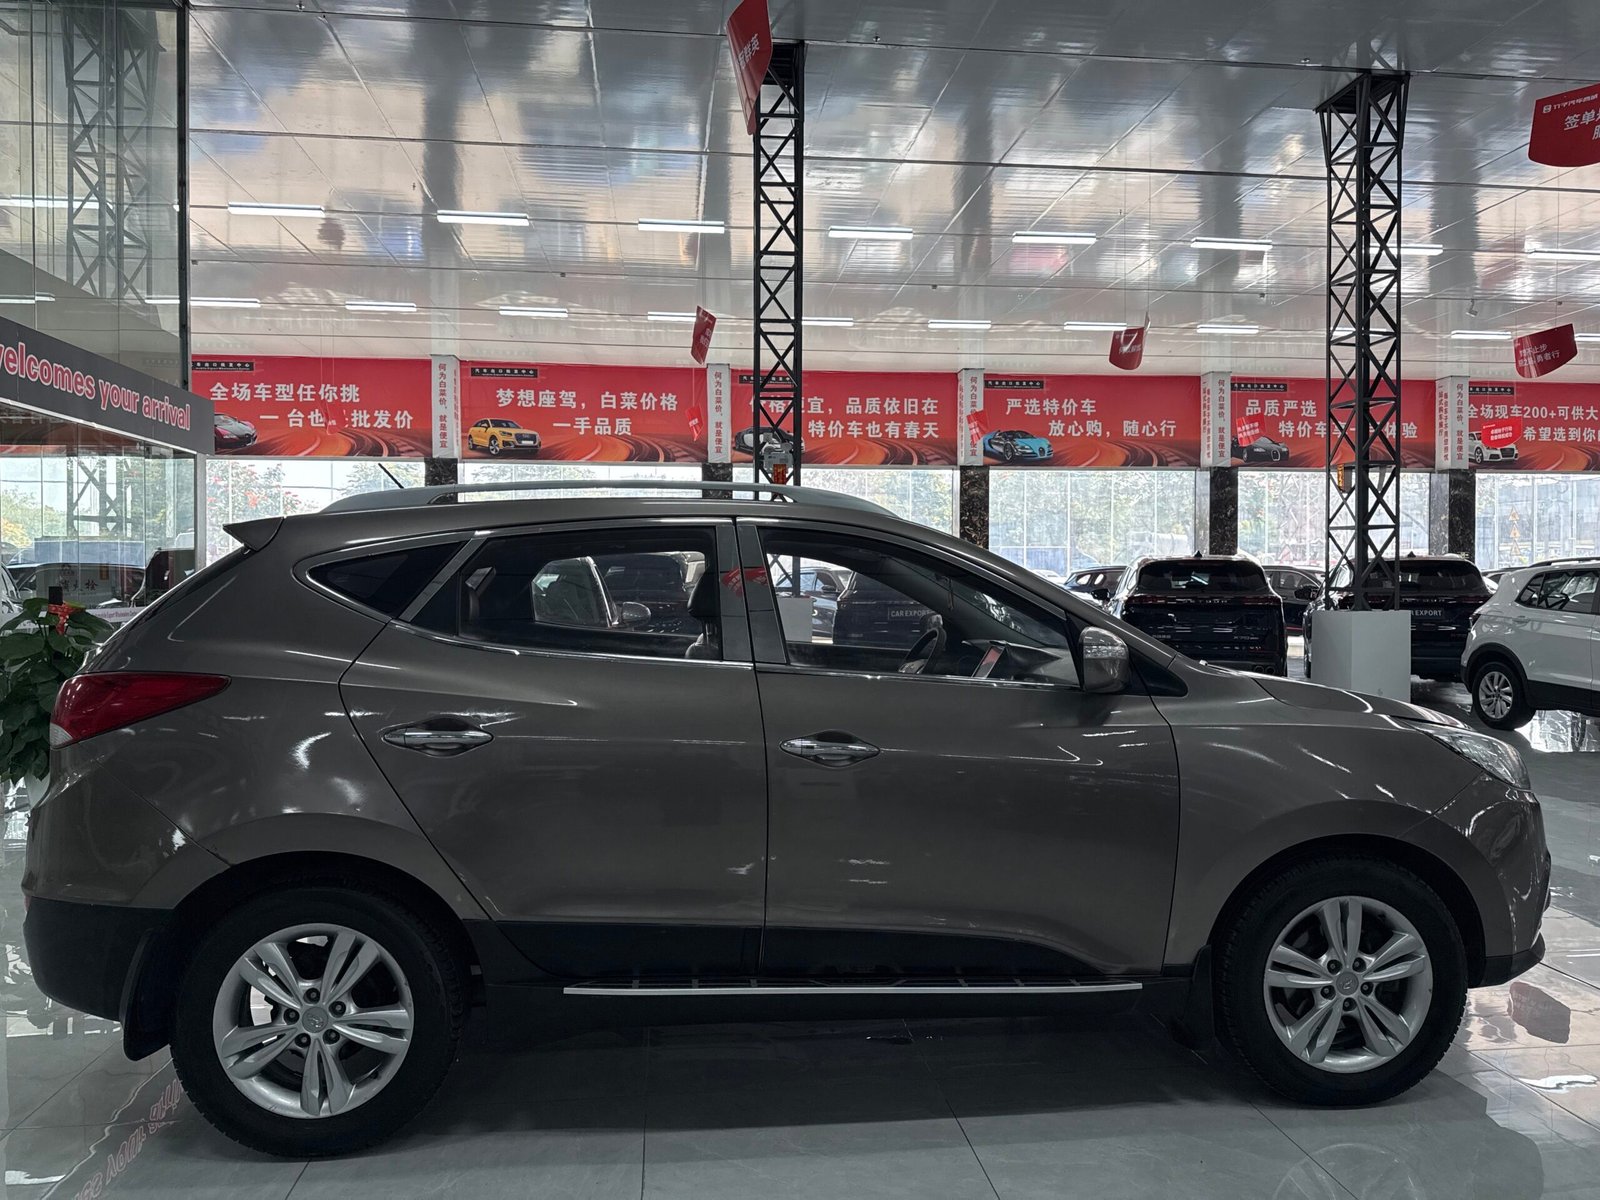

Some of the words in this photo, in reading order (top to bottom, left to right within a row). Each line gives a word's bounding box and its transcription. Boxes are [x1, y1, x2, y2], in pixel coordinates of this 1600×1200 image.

[0, 342, 95, 400] elcomes
[99, 378, 140, 411] your
[142, 395, 191, 431] arrival
[210, 383, 360, 403] 全场车型任你挑
[496, 388, 678, 411] 梦想座驾，白菜价格
[749, 395, 939, 416] 格宜，品质依旧在
[1006, 398, 1097, 416] 严选特价车
[1245, 399, 1317, 417] 品质严选
[259, 408, 414, 429] 一台也批发价
[1468, 404, 1599, 421] 全场现车200+可供大
[552, 416, 633, 436] 一手品质
[808, 420, 940, 440] 特价车也有春天
[1048, 420, 1177, 438] 放心购，随心行
[1523, 426, 1600, 443] 希望选到你
